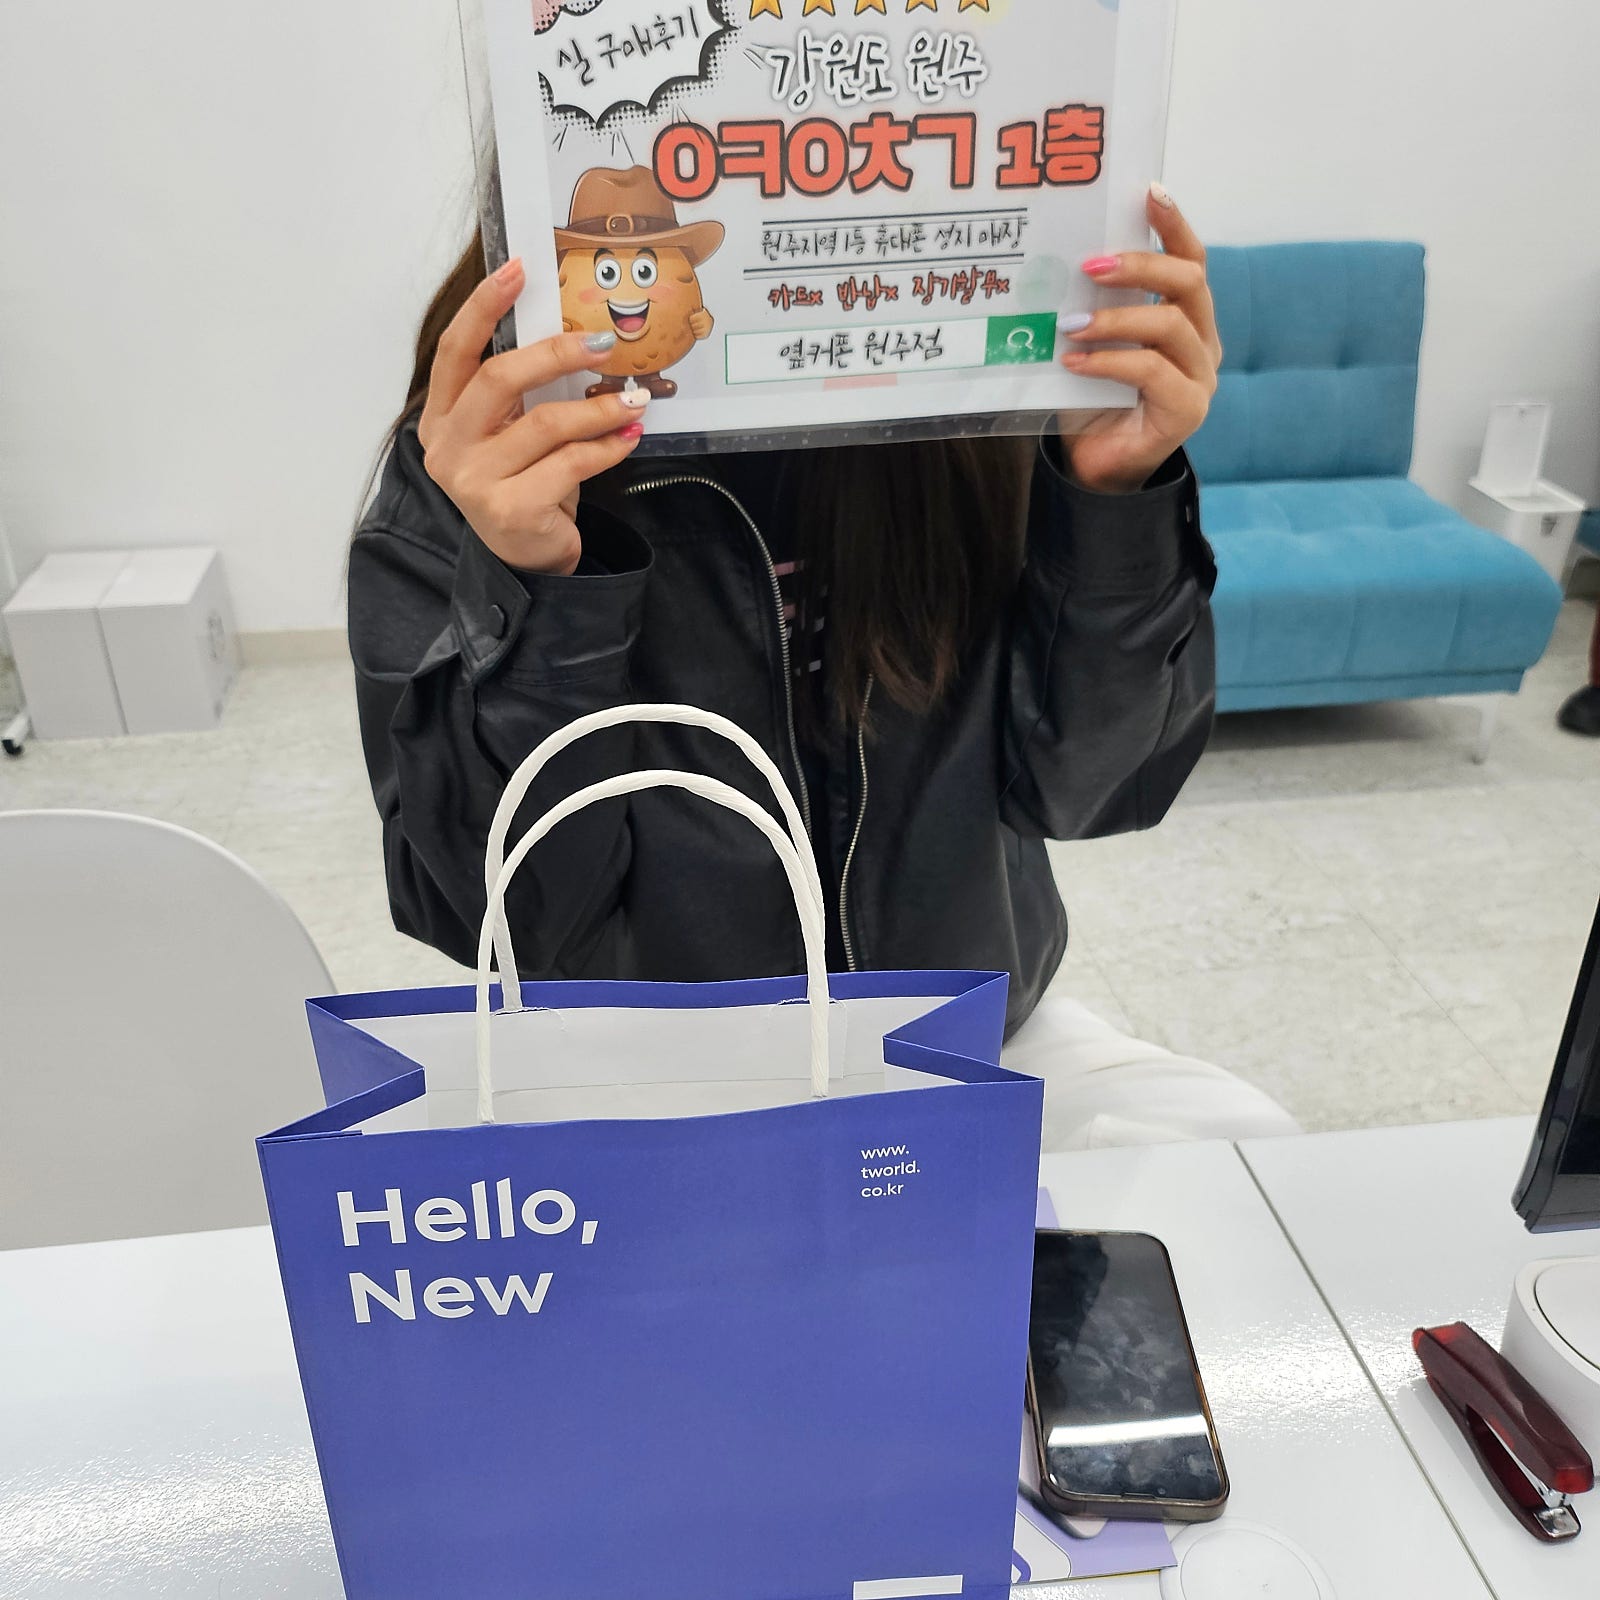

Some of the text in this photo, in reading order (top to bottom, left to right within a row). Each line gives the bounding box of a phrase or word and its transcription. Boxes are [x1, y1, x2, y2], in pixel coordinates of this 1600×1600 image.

[558, 7, 700, 86] 실 구매후기
[770, 35, 983, 106] 강원도 원주
[996, 104, 1104, 192] 1층
[761, 219, 1027, 260] 원주지역 1등 휴대폰 성지 매장
[780, 326, 943, 370] 옆커폰 원주점
[861, 1144, 910, 1160] www.
[861, 1160, 921, 1179] tworld.
[337, 1177, 599, 1246] Hello,
[861, 1183, 905, 1198] co.kr
[349, 1268, 553, 1324] New
